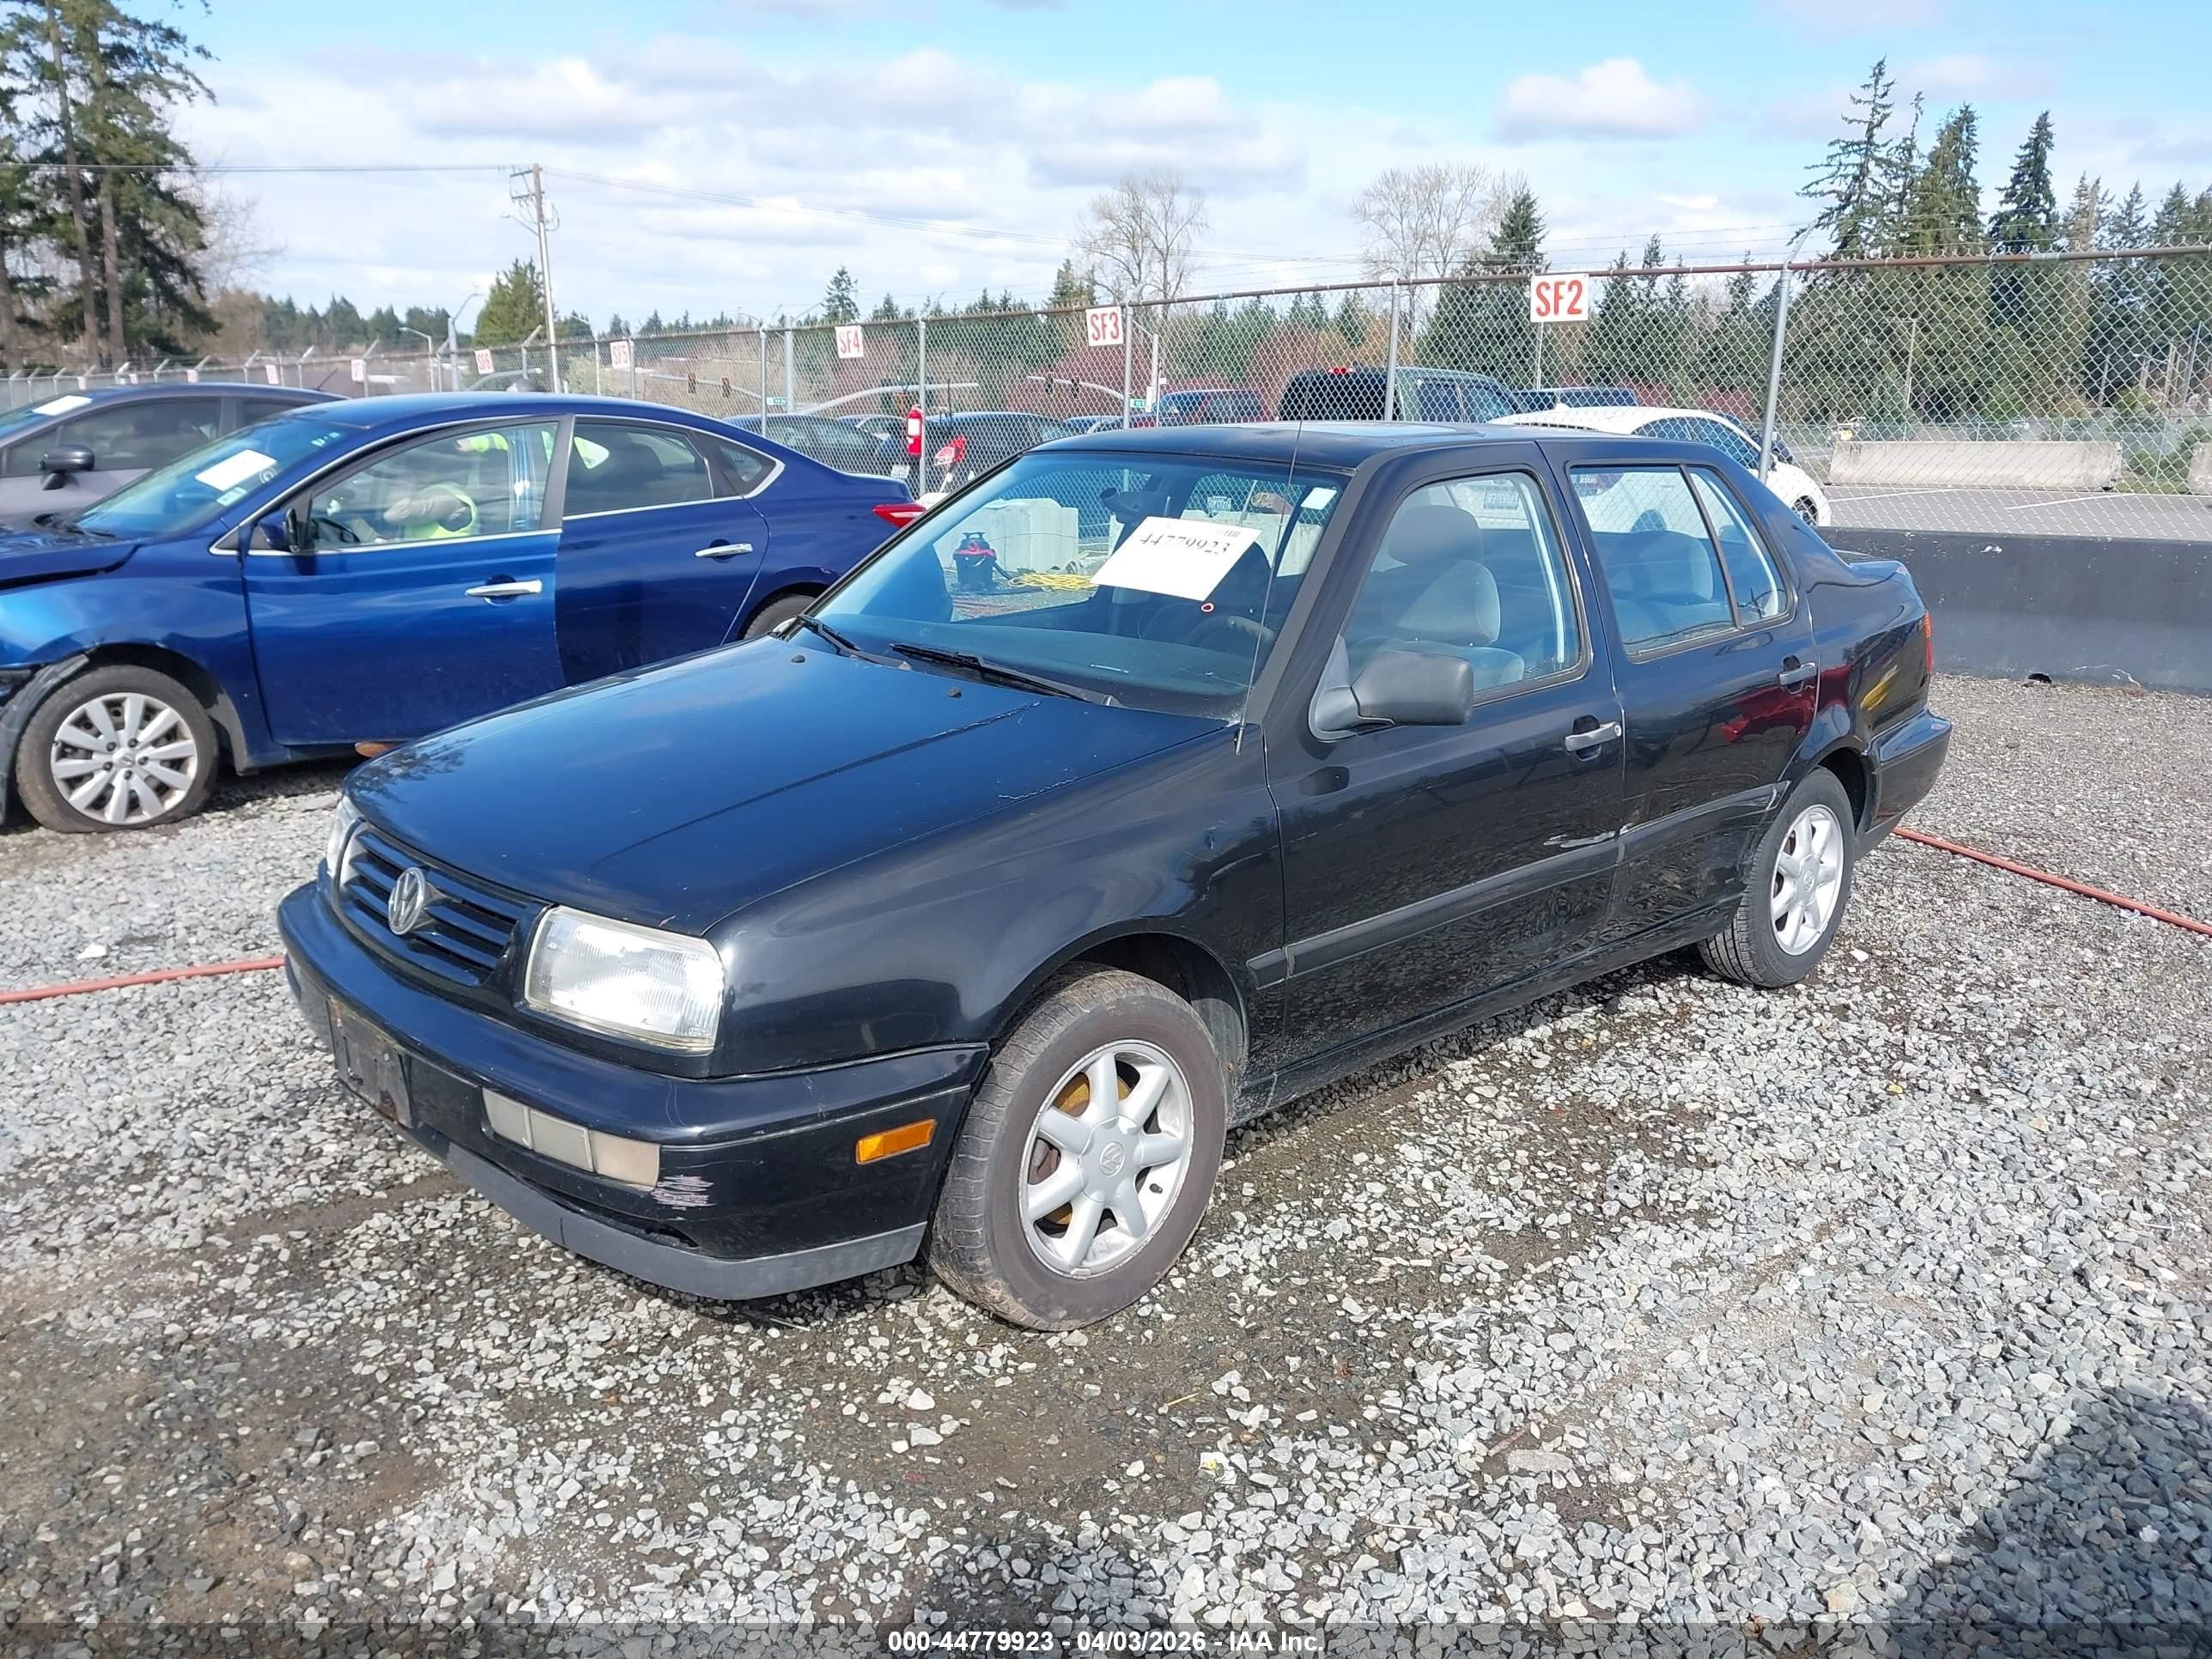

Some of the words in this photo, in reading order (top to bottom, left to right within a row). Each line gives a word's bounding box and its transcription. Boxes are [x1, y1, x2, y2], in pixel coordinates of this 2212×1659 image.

[1536, 280, 1582, 316] SF2
[1091, 312, 1119, 341] SF3
[839, 330, 860, 353] SF4
[1139, 533, 1231, 554] 44779923
